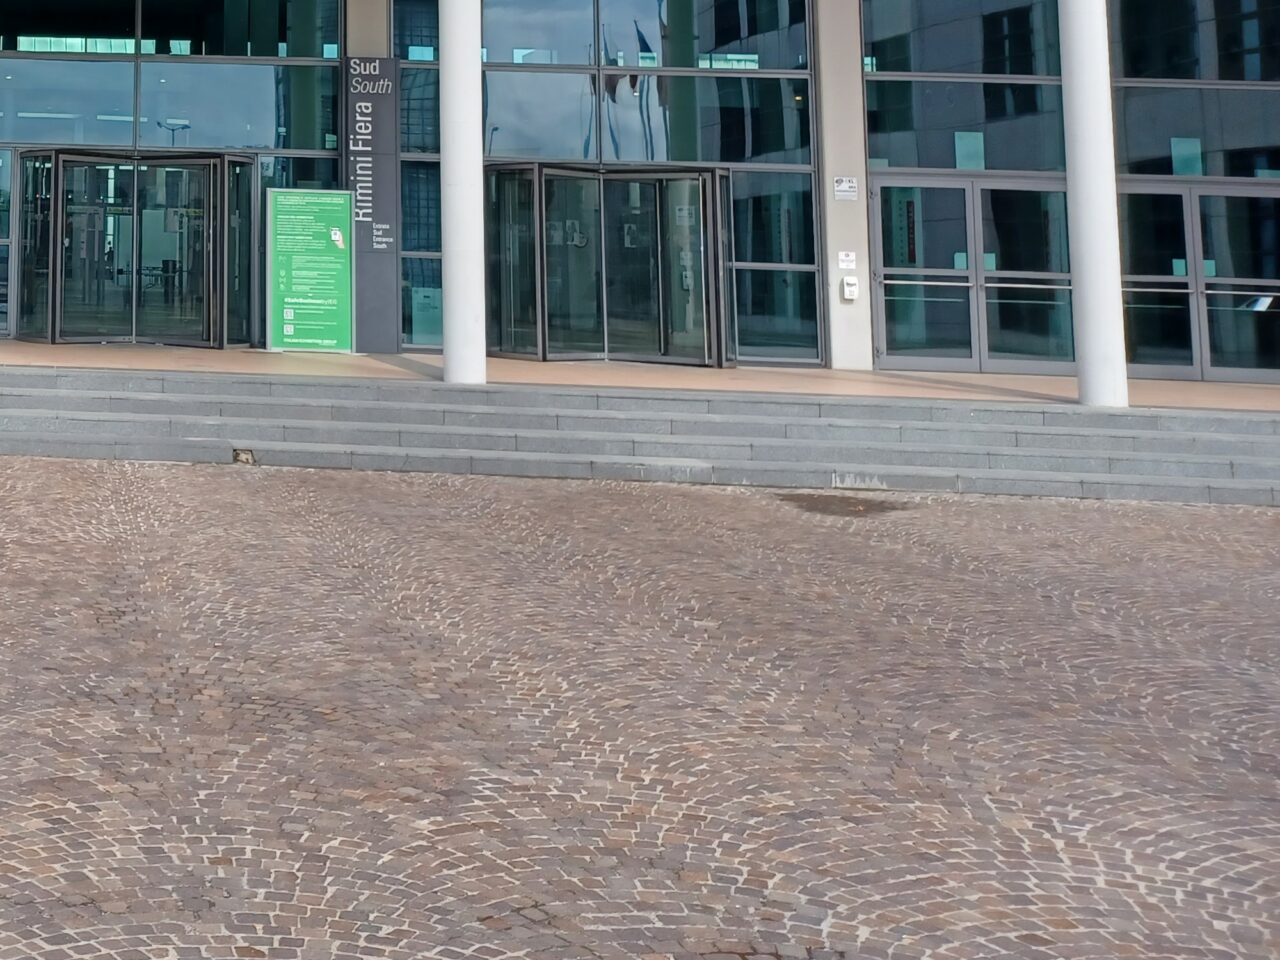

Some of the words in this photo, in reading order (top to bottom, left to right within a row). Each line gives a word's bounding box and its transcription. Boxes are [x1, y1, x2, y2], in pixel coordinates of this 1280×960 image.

[350, 59, 380, 75] Sud
[350, 77, 393, 94] South
[349, 102, 373, 151] Fiera
[350, 156, 373, 221] Rimini
